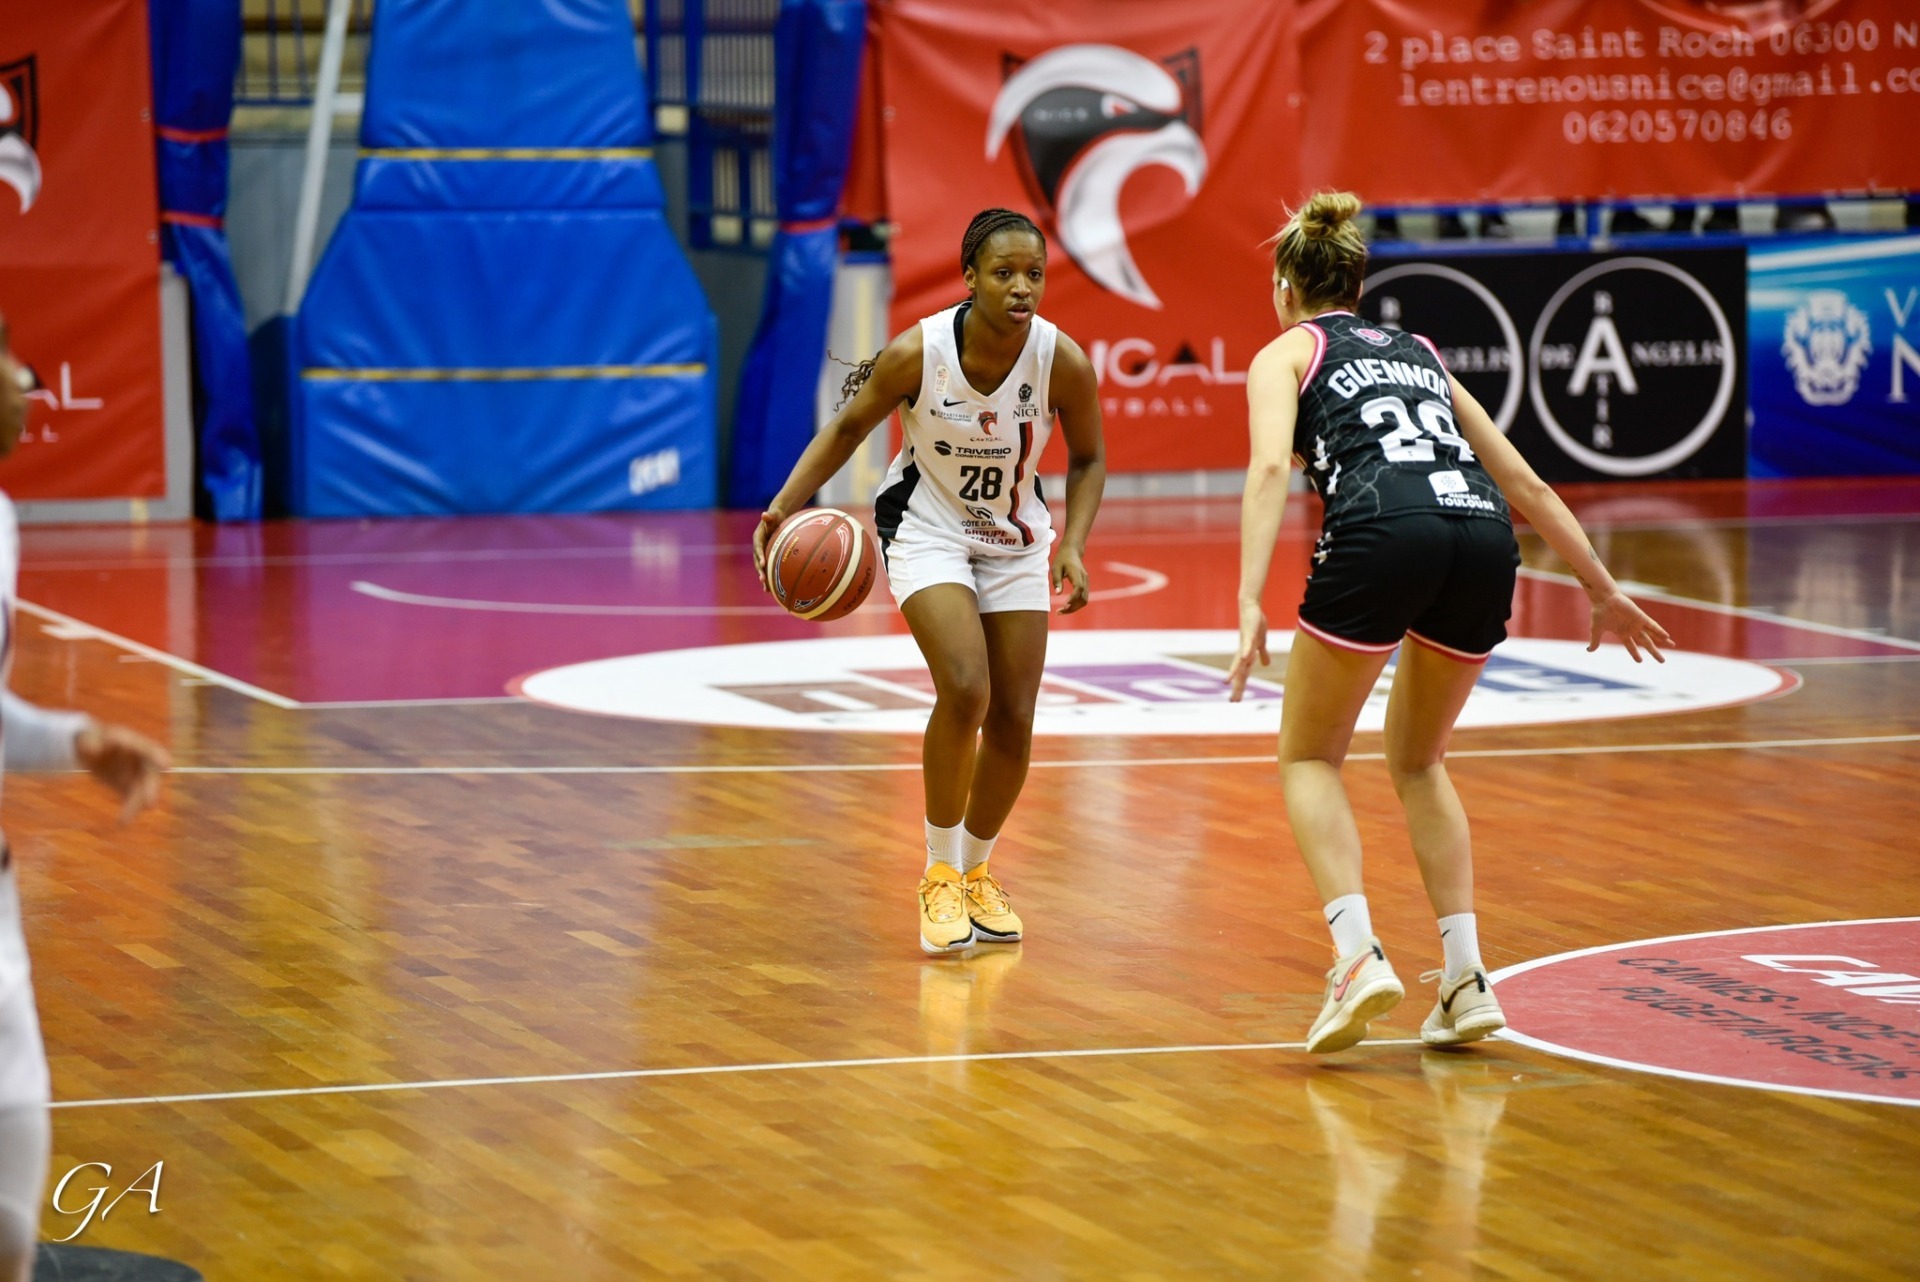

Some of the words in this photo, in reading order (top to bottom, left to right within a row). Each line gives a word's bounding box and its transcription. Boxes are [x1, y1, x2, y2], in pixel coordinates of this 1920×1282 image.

[1363, 30, 1389, 65] 2
[1400, 29, 1522, 71] place
[1531, 25, 1646, 60] Saint
[1658, 26, 1755, 58] Roch
[1769, 19, 1879, 56] 06300
[1893, 20, 1919, 49] N
[1398, 62, 1920, 106] lentrenousnice@gmail.co
[1562, 107, 1793, 145] 0620570846
[1013, 408, 1039, 419] NICE
[1102, 396, 1213, 418] TBALL
[956, 446, 1012, 455] TRIVERIO
[959, 465, 1003, 502] 28
[1436, 496, 1495, 511] TOULOUSE
[965, 528, 1008, 537] GROUPE
